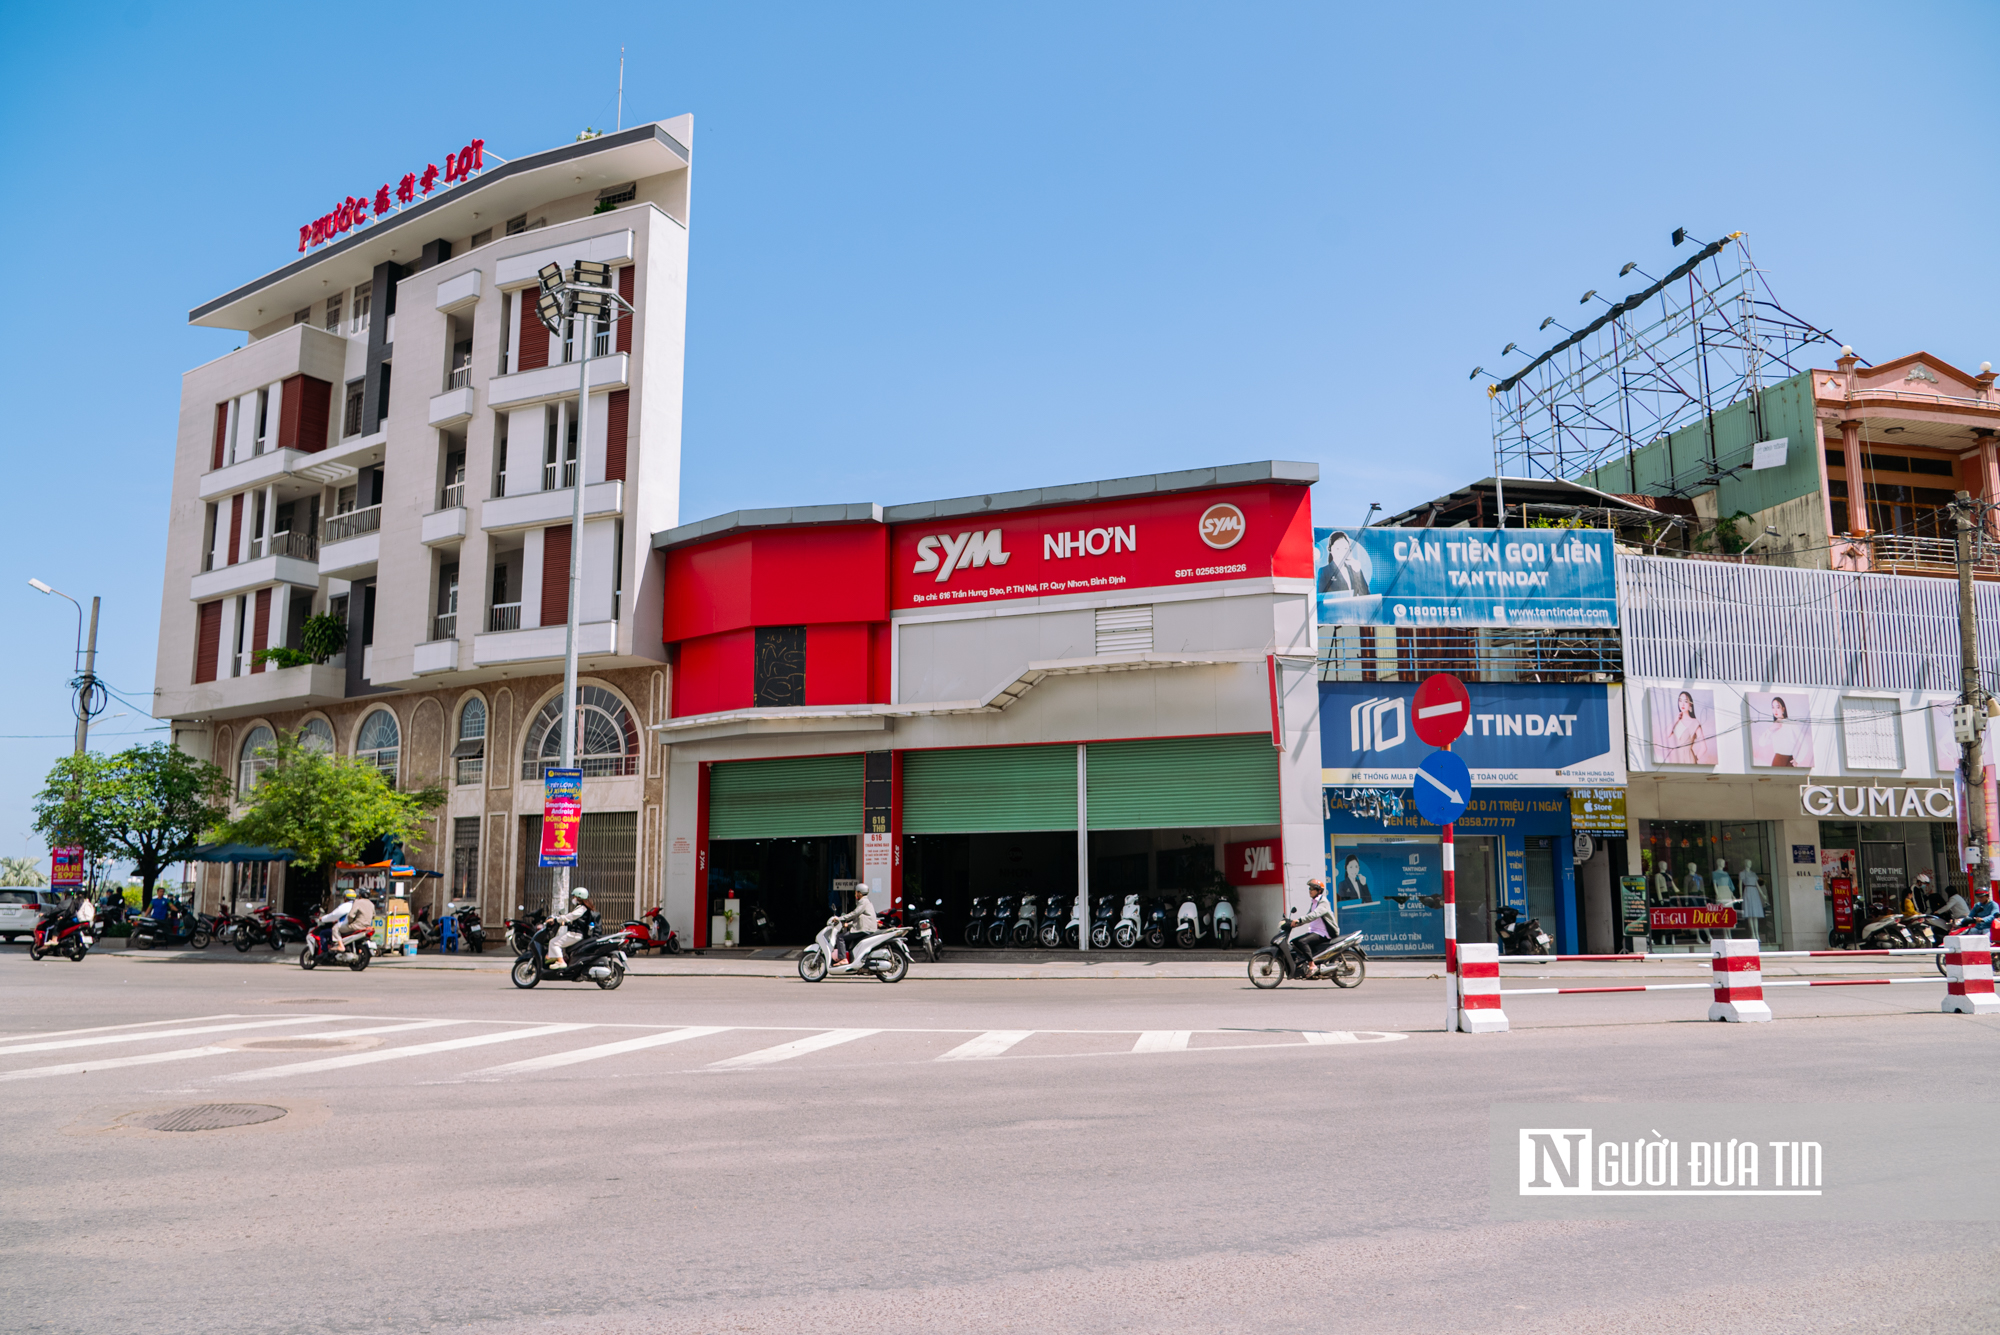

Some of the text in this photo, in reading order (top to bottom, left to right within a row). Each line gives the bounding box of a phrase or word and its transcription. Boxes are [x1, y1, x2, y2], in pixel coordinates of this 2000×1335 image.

[298, 195, 369, 253] PHƯỚC
[1202, 515, 1242, 536] SYM
[913, 524, 1136, 582] SYM NHƠN
[1394, 535, 1600, 568] CẦN TIỀN GỌI LIỀN
[1195, 564, 1246, 576] 02563812626
[968, 589, 988, 598] Hưng
[1050, 582, 1065, 590] Quy
[1409, 606, 1462, 617] 18001551
[1508, 606, 1608, 618] www.tantindat.com
[1498, 799, 1524, 813] TRIỆU
[1538, 801, 1562, 812] NGÀY
[1802, 786, 1955, 818] GUMAC
[872, 816, 885, 824] 616
[1406, 815, 1418, 828] HỆ
[1459, 818, 1498, 827] 0358.777
[1501, 818, 1515, 827] 777
[1244, 846, 1275, 878] SYM
